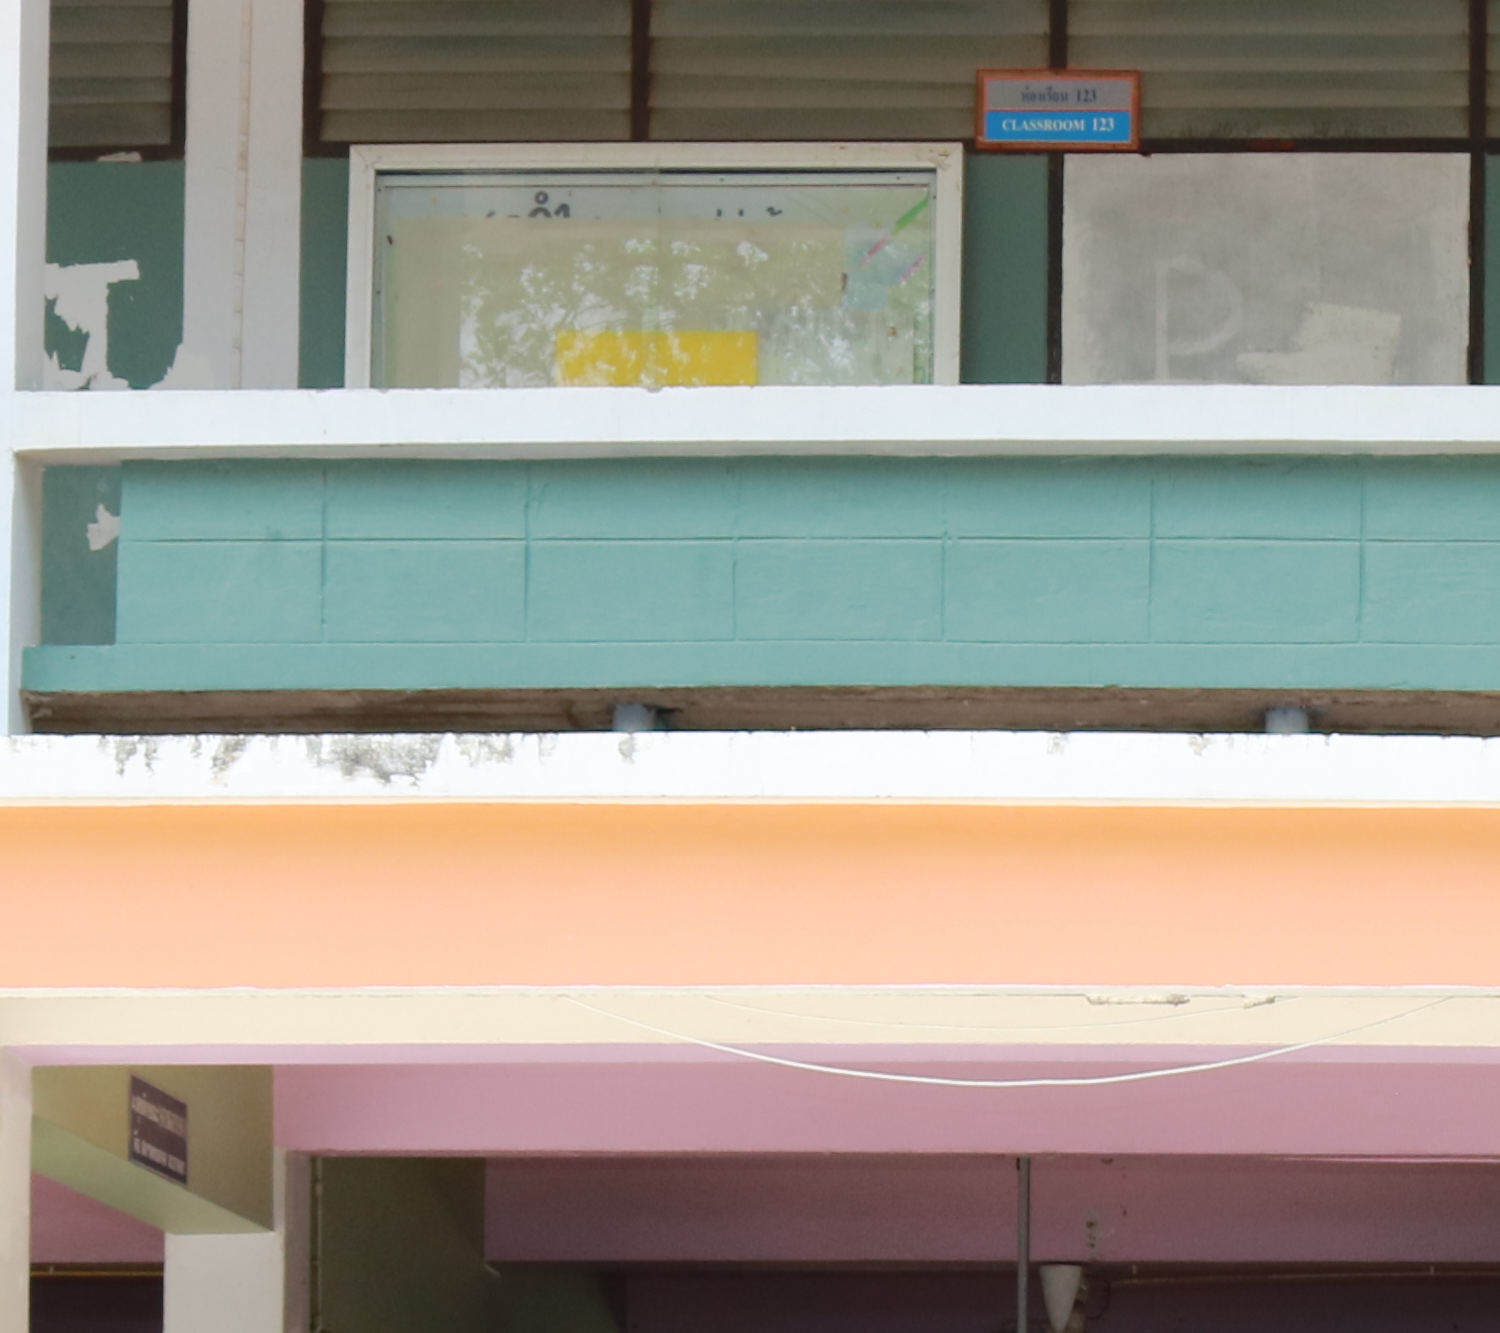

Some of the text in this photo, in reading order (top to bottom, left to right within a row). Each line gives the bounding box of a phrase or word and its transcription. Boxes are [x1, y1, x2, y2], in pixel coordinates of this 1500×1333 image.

[1076, 89, 1097, 103] 123
[1002, 117, 1115, 132] CLASSROOM 123
